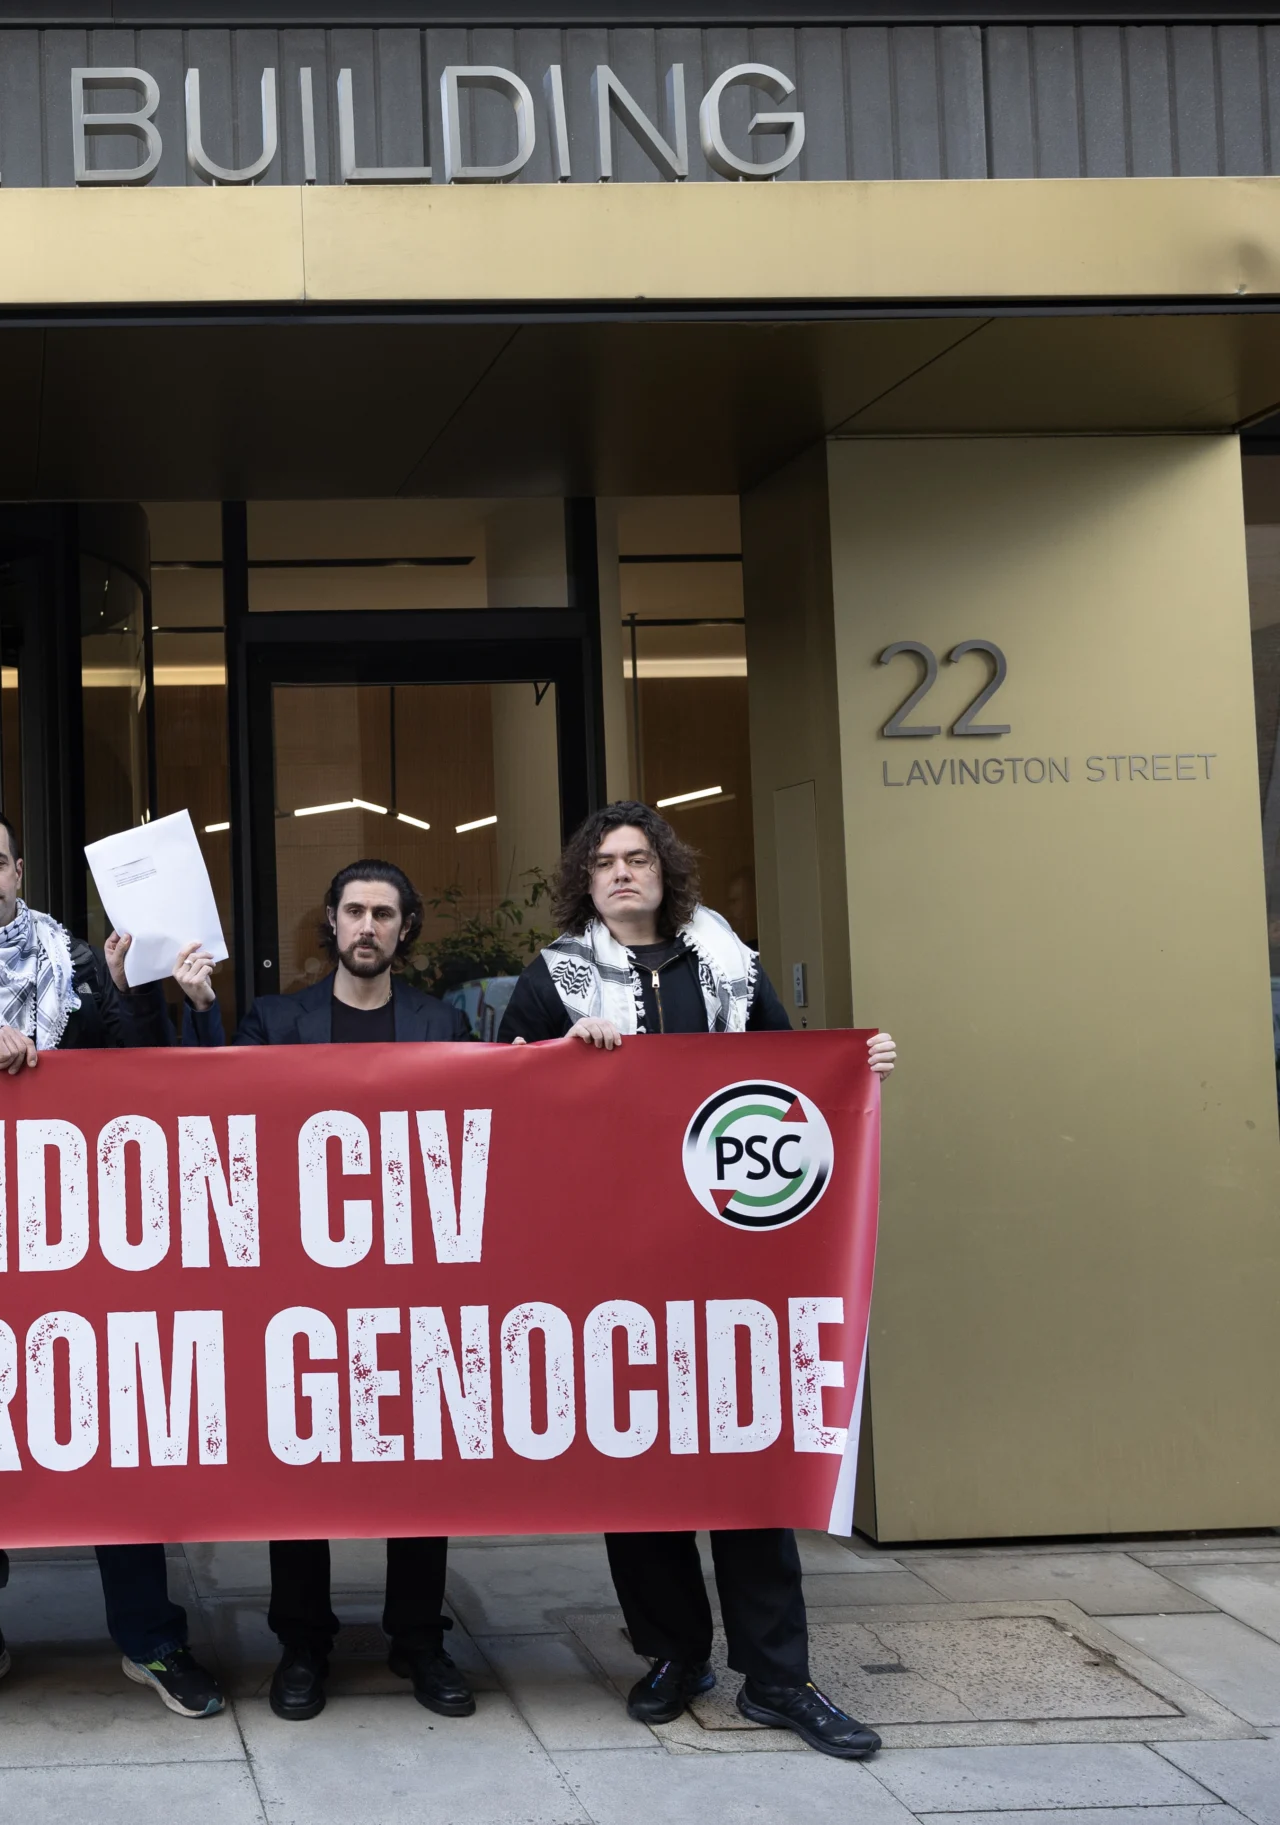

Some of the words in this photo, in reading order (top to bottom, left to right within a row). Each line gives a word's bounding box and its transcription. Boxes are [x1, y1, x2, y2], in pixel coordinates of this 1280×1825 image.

[71, 62, 806, 185] BUILDING
[879, 639, 1011, 737] 22
[882, 756, 1070, 787] LAVINGTON
[1086, 753, 1217, 782] STREET
[298, 1109, 492, 1268] CIV
[715, 1134, 803, 1181] PSC
[264, 1297, 848, 1466] GENOCIDE
